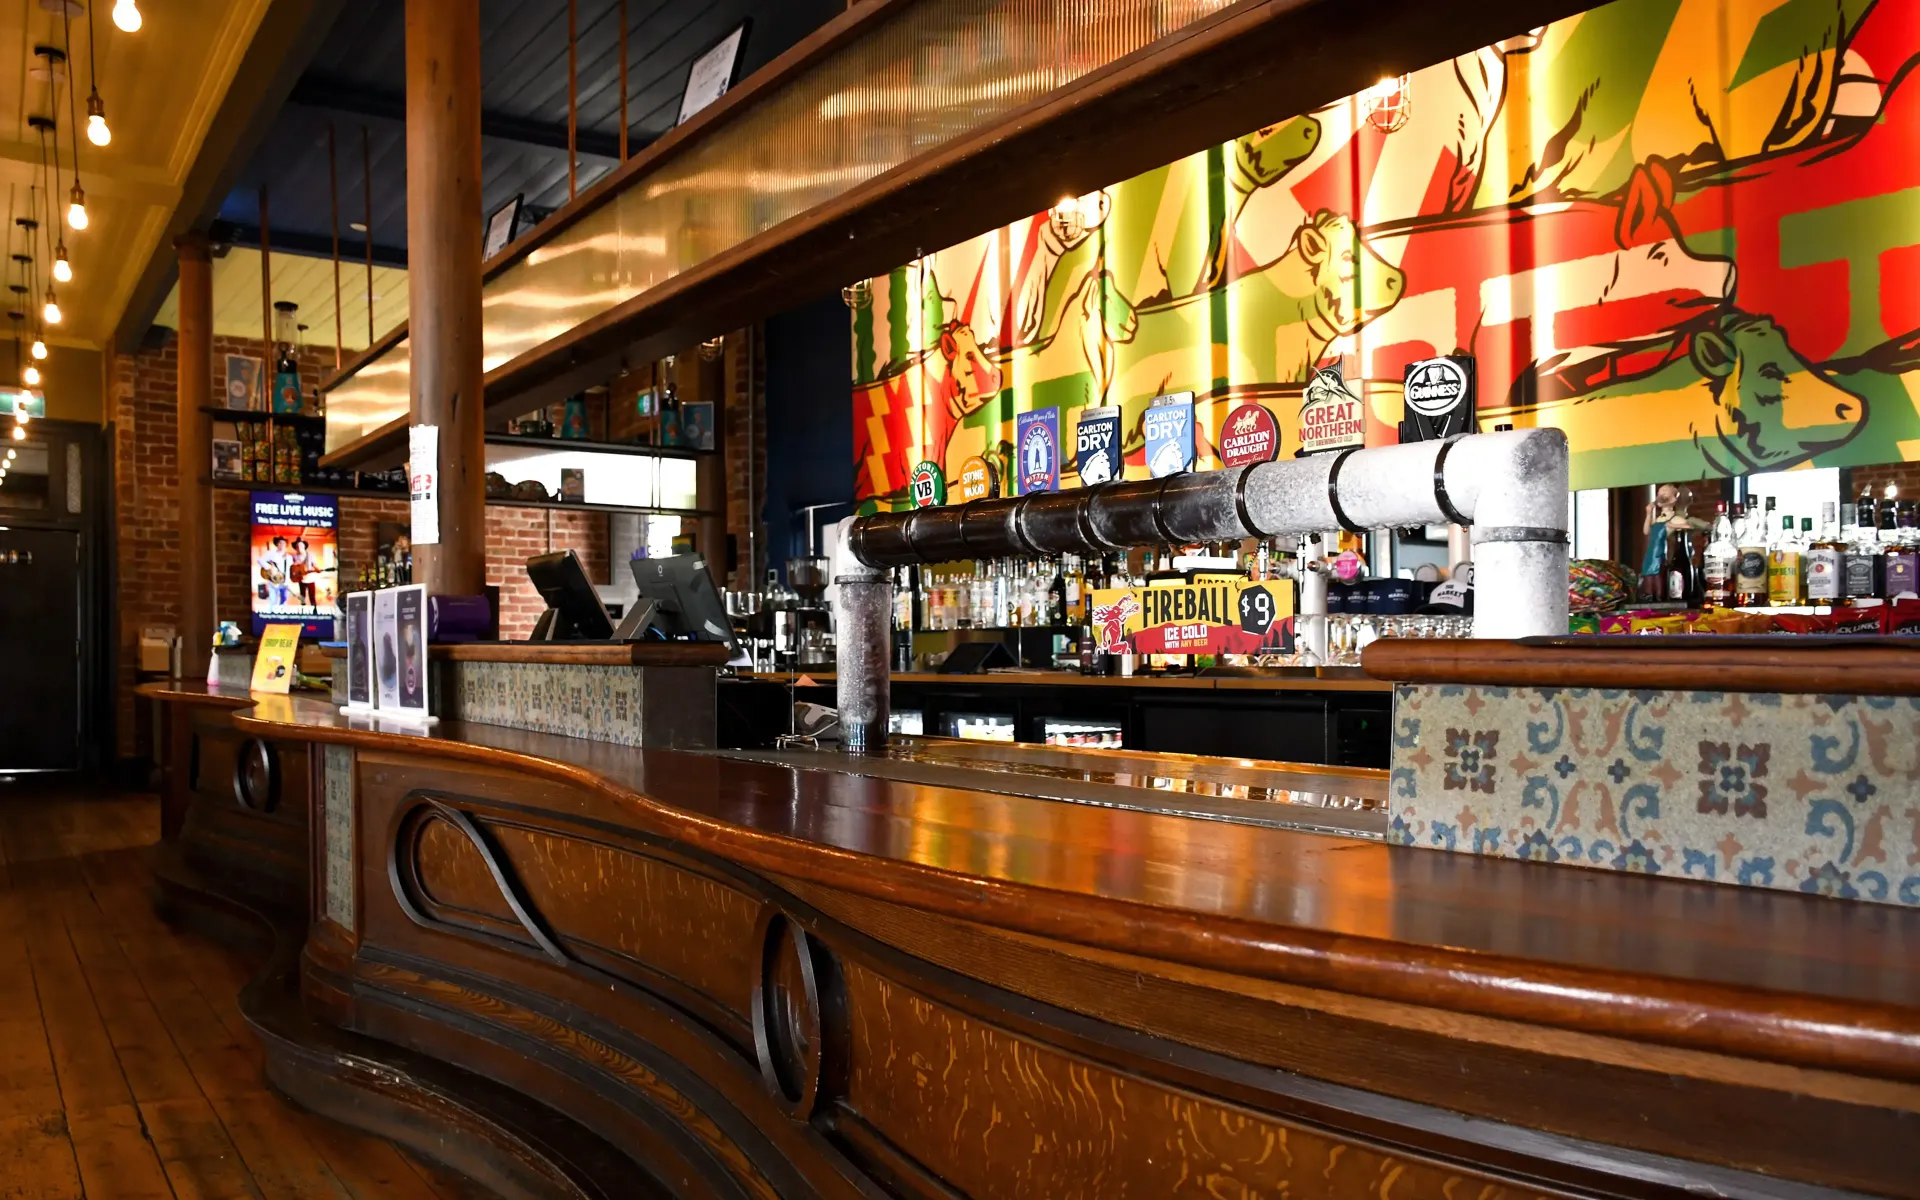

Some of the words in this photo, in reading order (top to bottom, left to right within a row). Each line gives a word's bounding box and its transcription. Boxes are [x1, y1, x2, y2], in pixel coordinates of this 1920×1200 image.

[1410, 383, 1460, 400] GUINNESS
[1147, 409, 1187, 423] CARLTON
[1305, 402, 1354, 426] GREAT
[1077, 421, 1112, 436] CARLTON
[1146, 418, 1187, 441] DRY
[1299, 419, 1362, 443] NORTHERN
[1024, 427, 1051, 451] BALLARAT
[1077, 431, 1113, 452] DRY
[1223, 430, 1270, 449] CARLTON
[1226, 441, 1269, 459] DRAUGHT
[910, 462, 938, 485] VICTORIA
[962, 468, 985, 485] STONE
[1025, 473, 1049, 485] BITTER
[916, 480, 933, 498] VB
[963, 484, 985, 498] WOOD
[255, 503, 279, 515] FREE
[280, 505, 302, 516] LIVE
[303, 506, 334, 518] MUSIC
[1437, 590, 1463, 598] MARKET
[1143, 586, 1233, 628] FIREBALL
[1164, 627, 1180, 641] ICE
[1181, 624, 1207, 640] COLD
[1165, 641, 1179, 649] WITH
[1181, 640, 1193, 648] ANY
[1193, 638, 1208, 647] BEER
